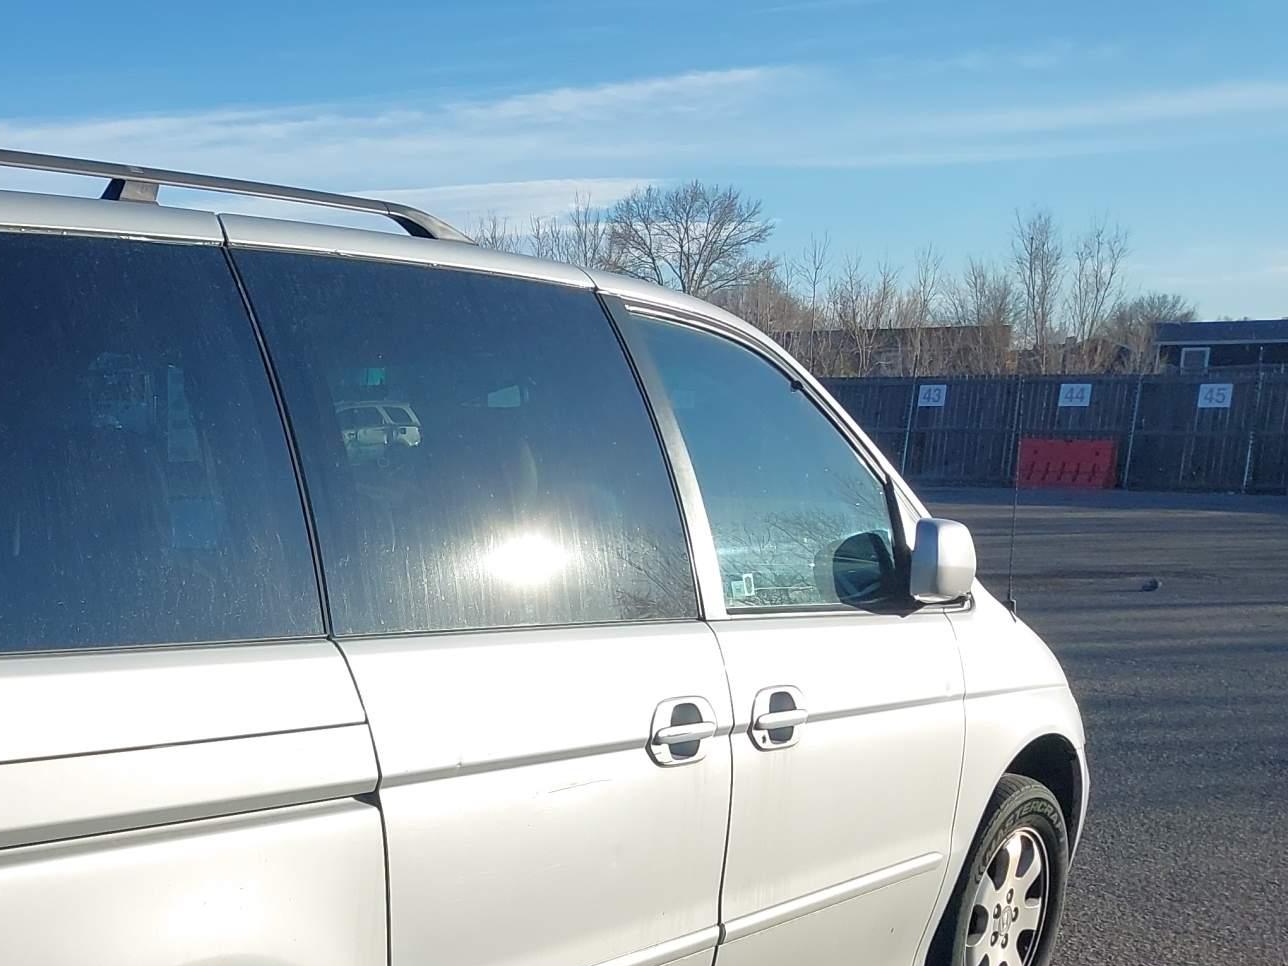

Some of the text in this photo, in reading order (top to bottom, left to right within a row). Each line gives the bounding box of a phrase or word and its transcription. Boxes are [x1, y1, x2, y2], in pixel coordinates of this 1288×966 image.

[922, 387, 942, 403] 43
[1064, 387, 1086, 403] 44
[1203, 387, 1226, 404] 45
